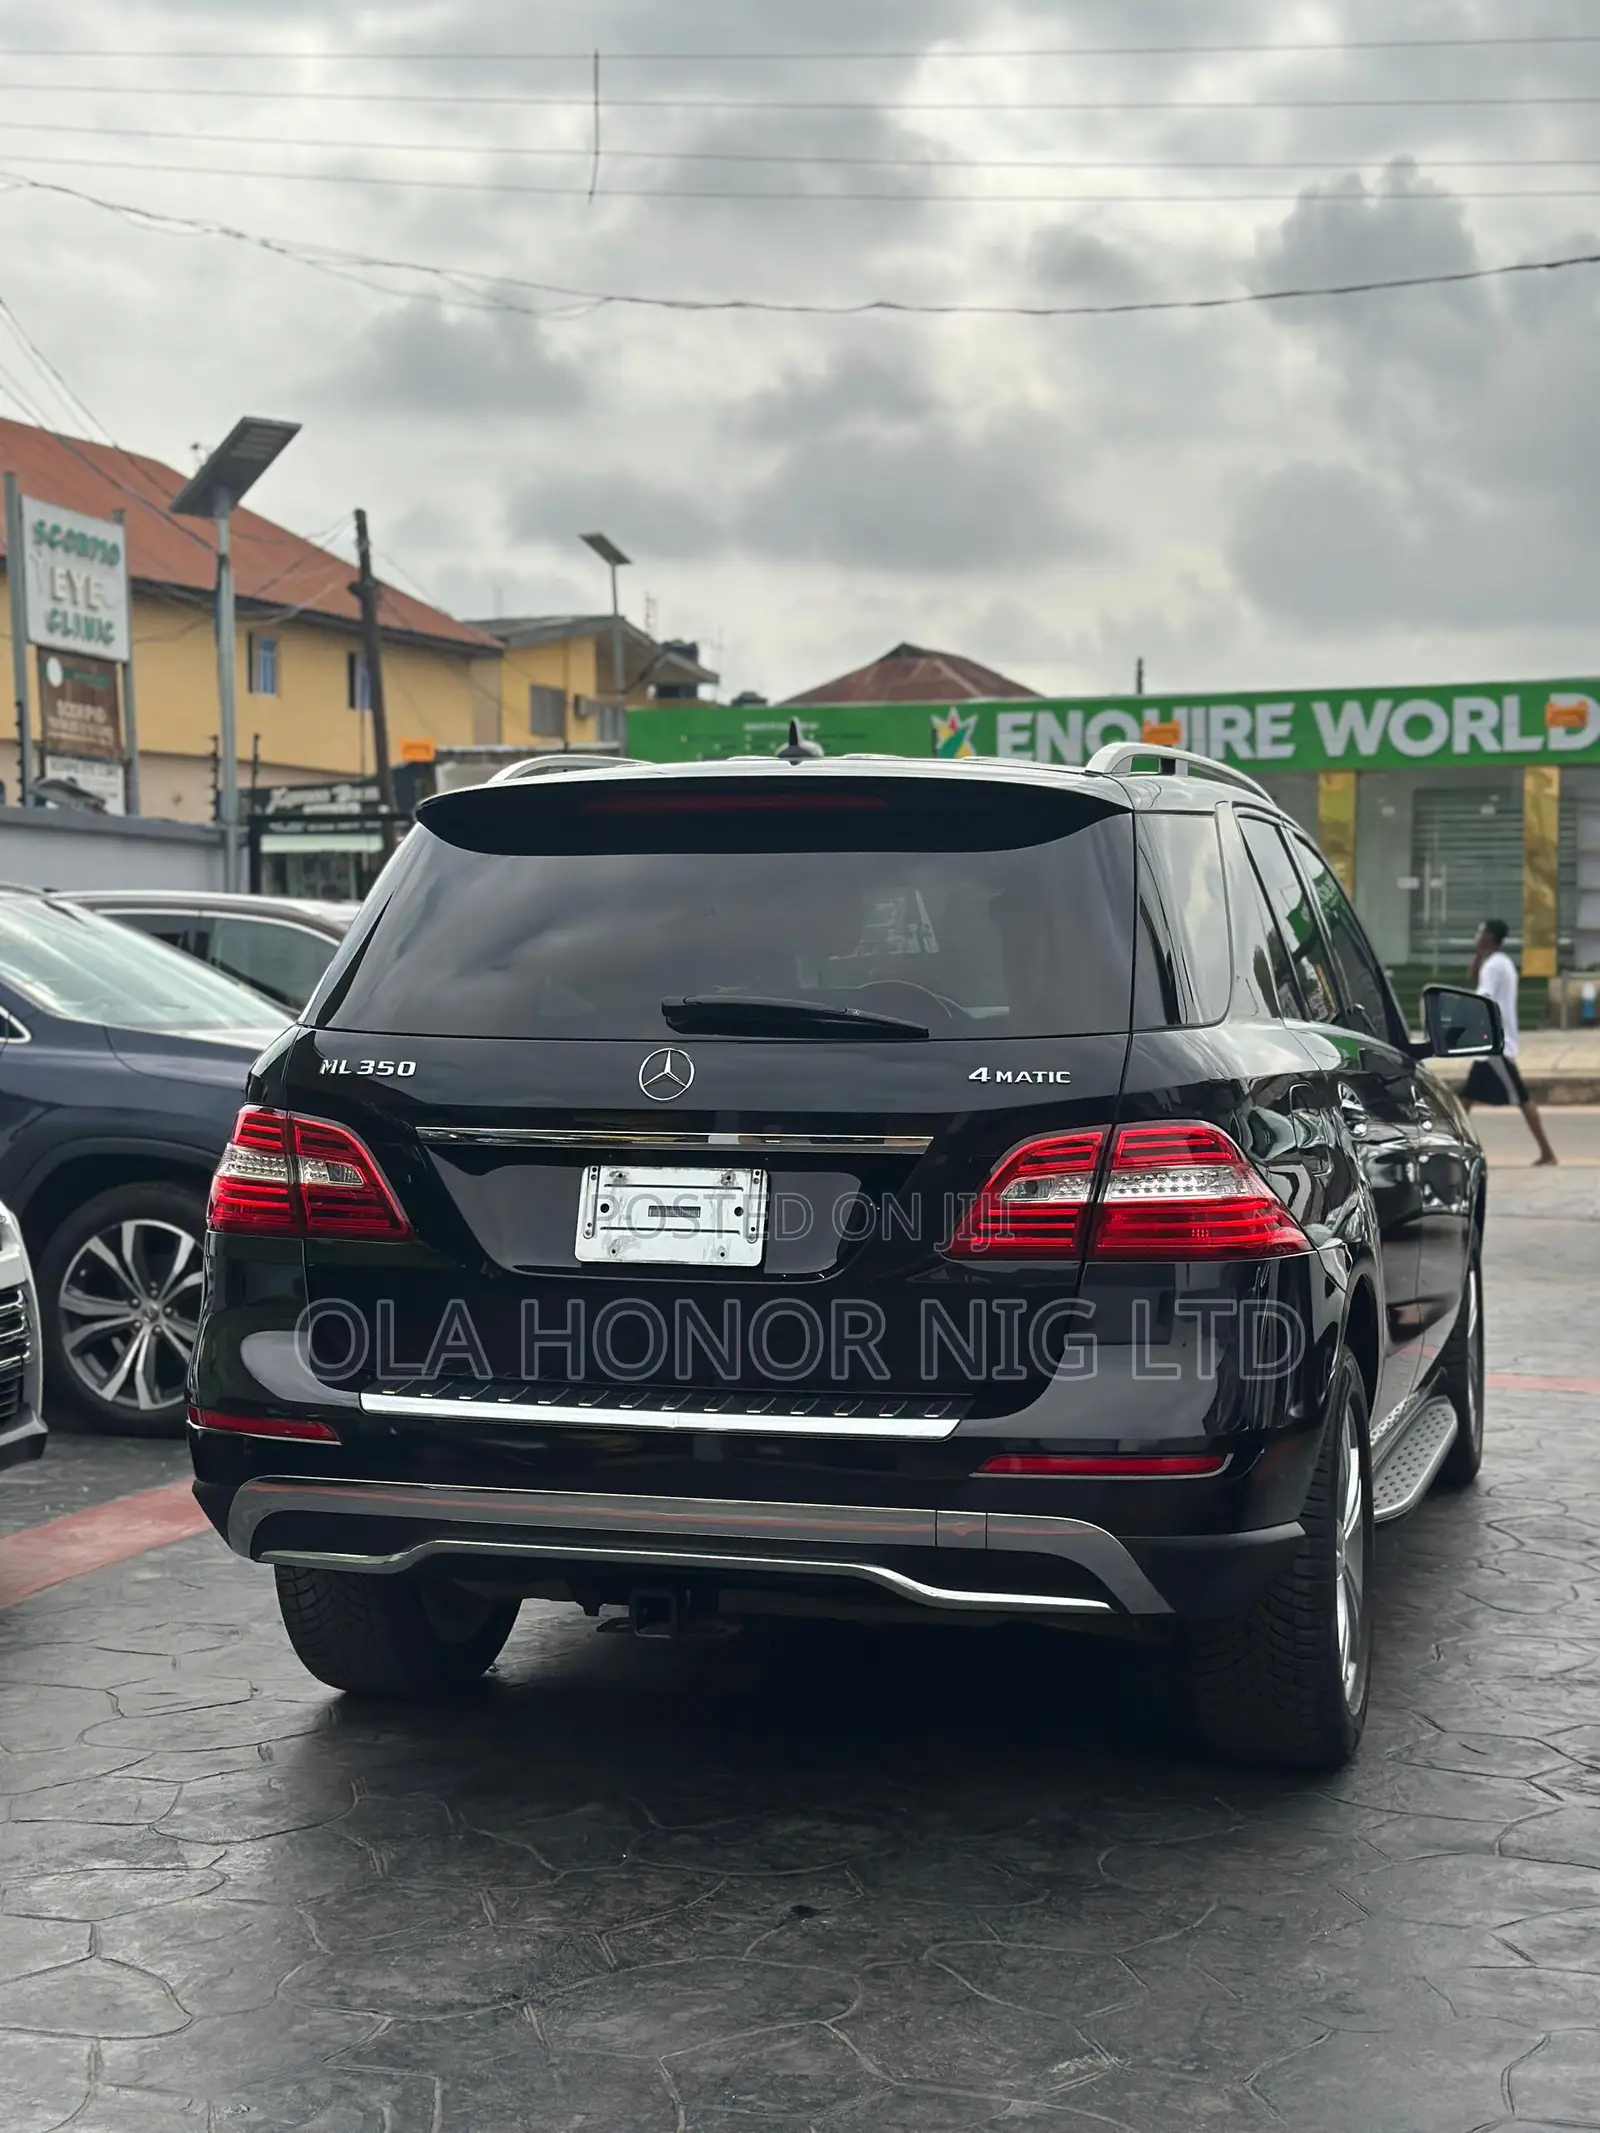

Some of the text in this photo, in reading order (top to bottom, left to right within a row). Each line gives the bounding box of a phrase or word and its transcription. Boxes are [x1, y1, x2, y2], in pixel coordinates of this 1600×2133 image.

[50, 565, 104, 611] EYE
[46, 607, 115, 645] CLINIC
[1311, 693, 1600, 757] WORLD
[320, 1059, 417, 1077] ML 350
